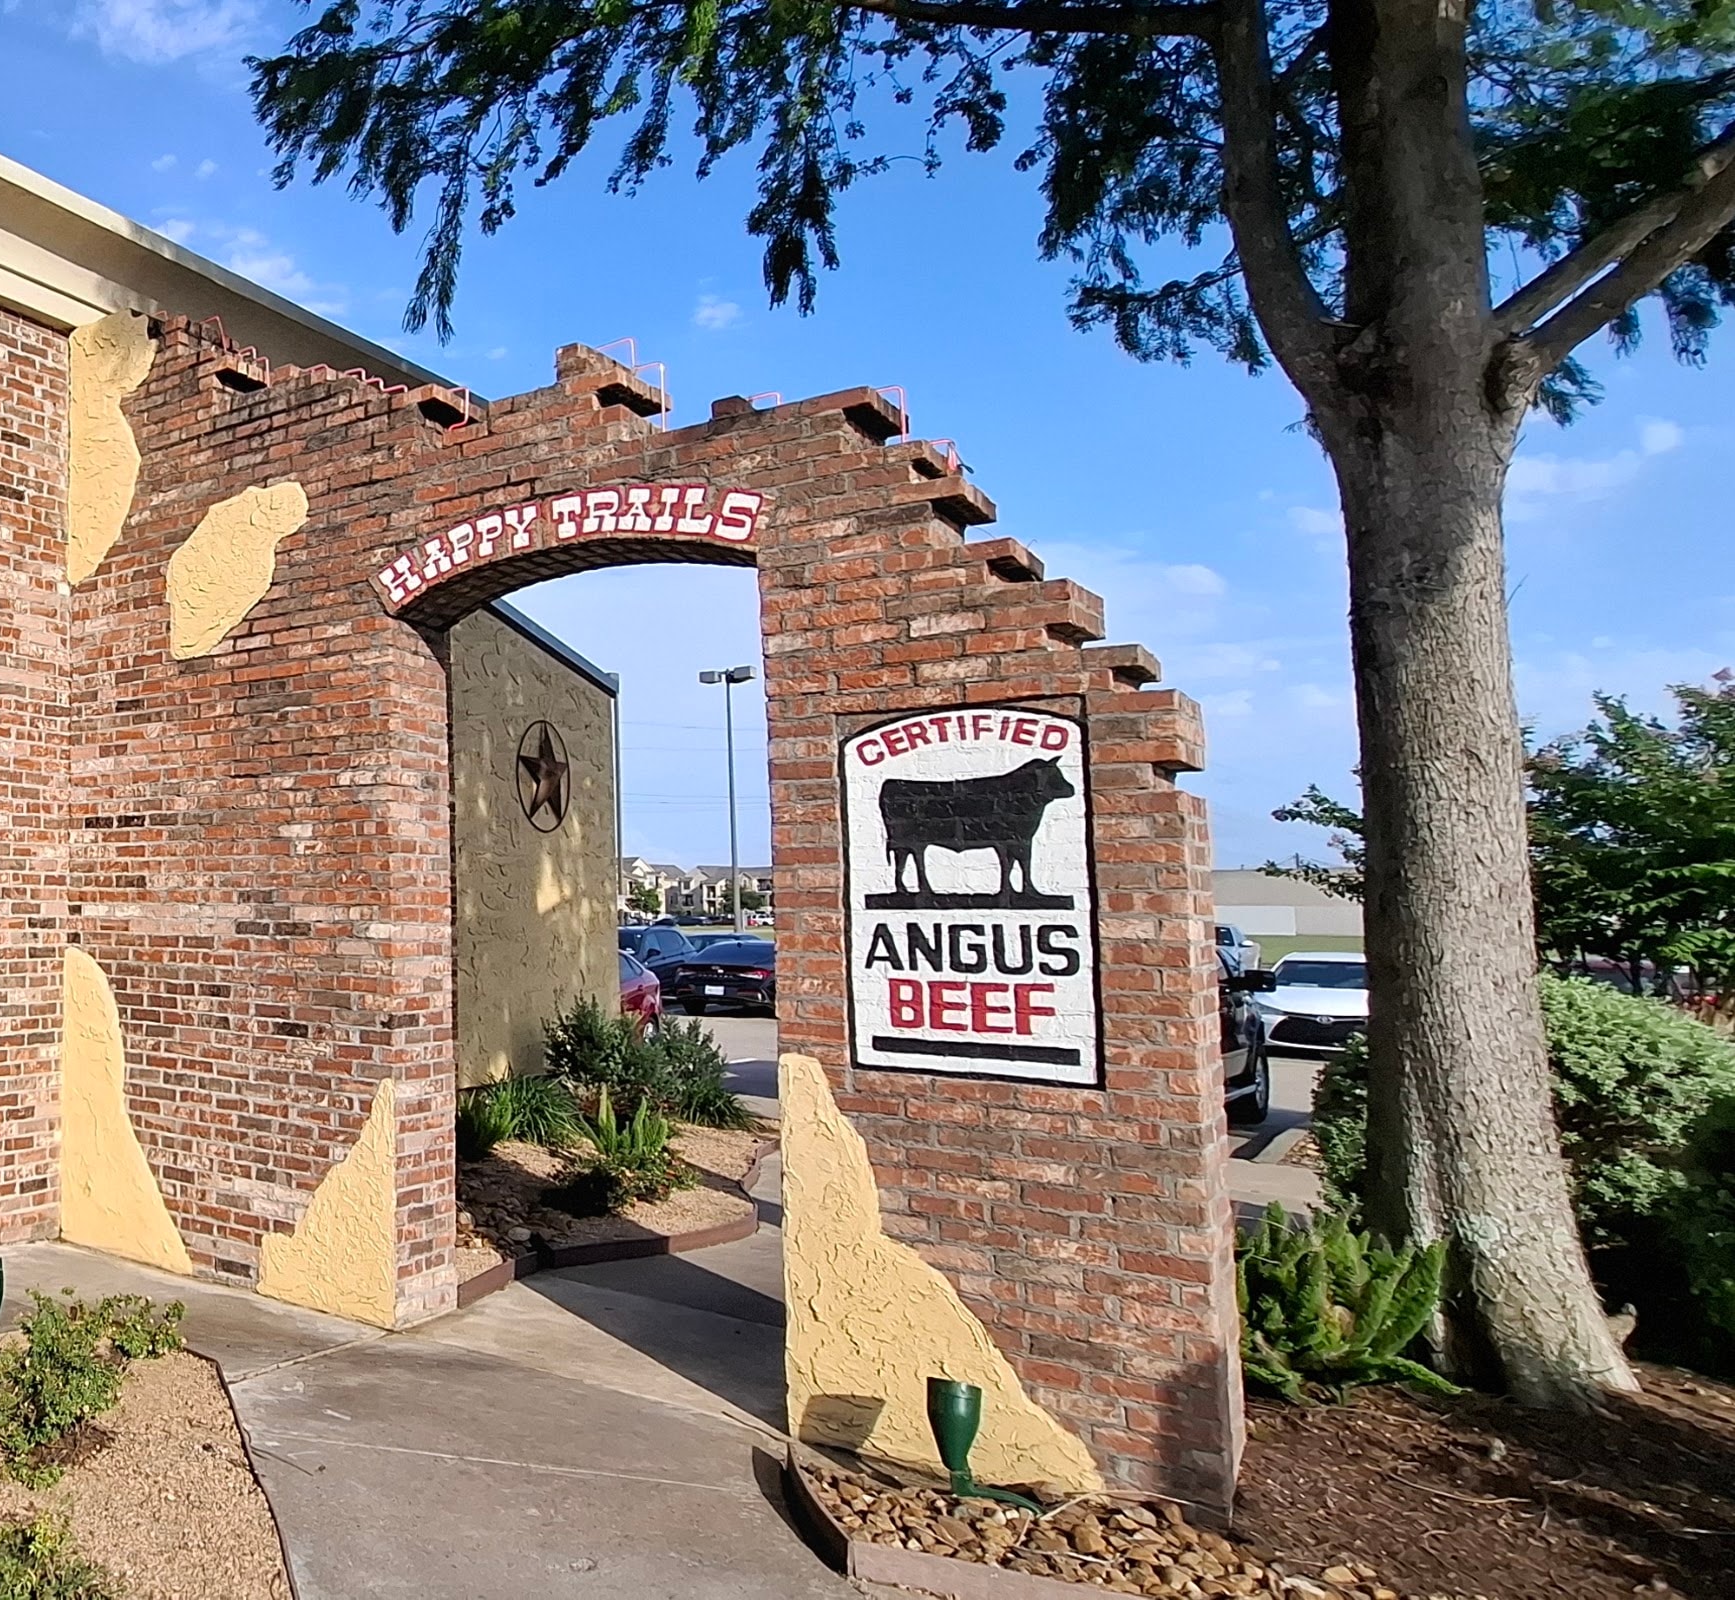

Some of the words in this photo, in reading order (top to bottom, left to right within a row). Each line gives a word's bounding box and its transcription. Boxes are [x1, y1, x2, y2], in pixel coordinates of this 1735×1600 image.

[378, 503, 538, 604] HAPPY
[552, 484, 763, 542] TRAILS
[856, 714, 1070, 767] CERTIFIED
[865, 922, 1080, 977] ANGUS
[889, 977, 1056, 1035] BEEF
